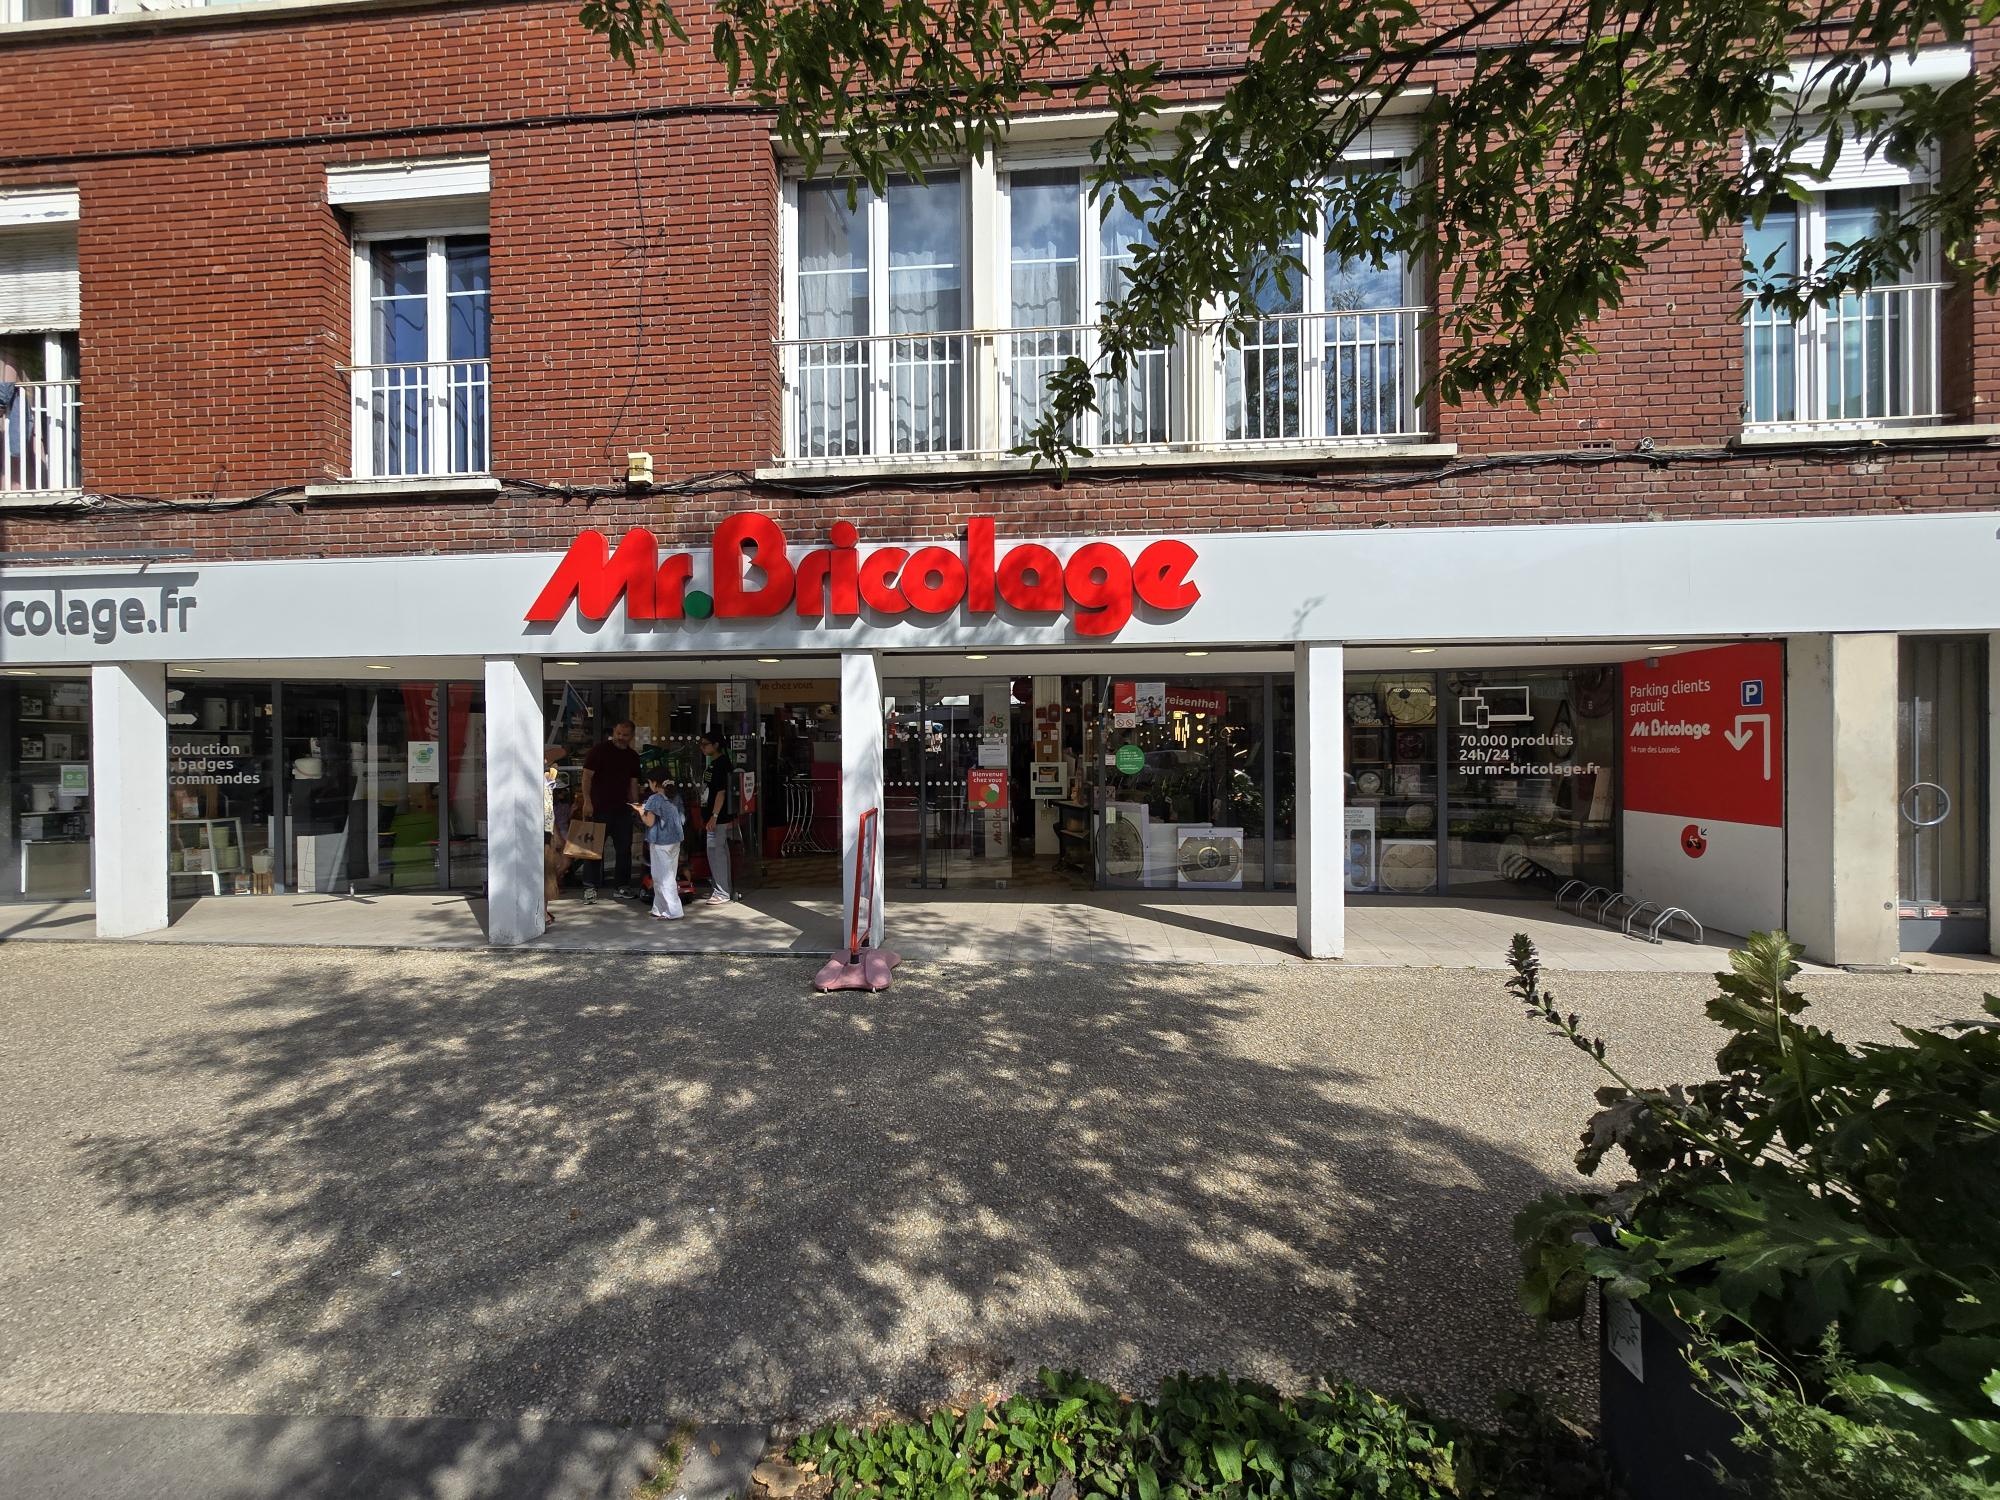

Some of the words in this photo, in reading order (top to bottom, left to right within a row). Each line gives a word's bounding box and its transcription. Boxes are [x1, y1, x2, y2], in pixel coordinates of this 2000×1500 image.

[793, 680, 814, 690] vous
[1630, 683, 1669, 699] Parking
[1671, 679, 1711, 695] clients
[1630, 699, 1665, 716] gratuit
[1651, 718, 1711, 740] Bricolage
[1459, 735, 1508, 746] 70.000
[1511, 734, 1574, 748] produits
[1459, 749, 1510, 763] 24h/24
[178, 757, 234, 772] badges
[1459, 765, 1484, 775] sur
[1484, 763, 1601, 777] mr-bricolage.fr
[168, 772, 261, 785] commandes
